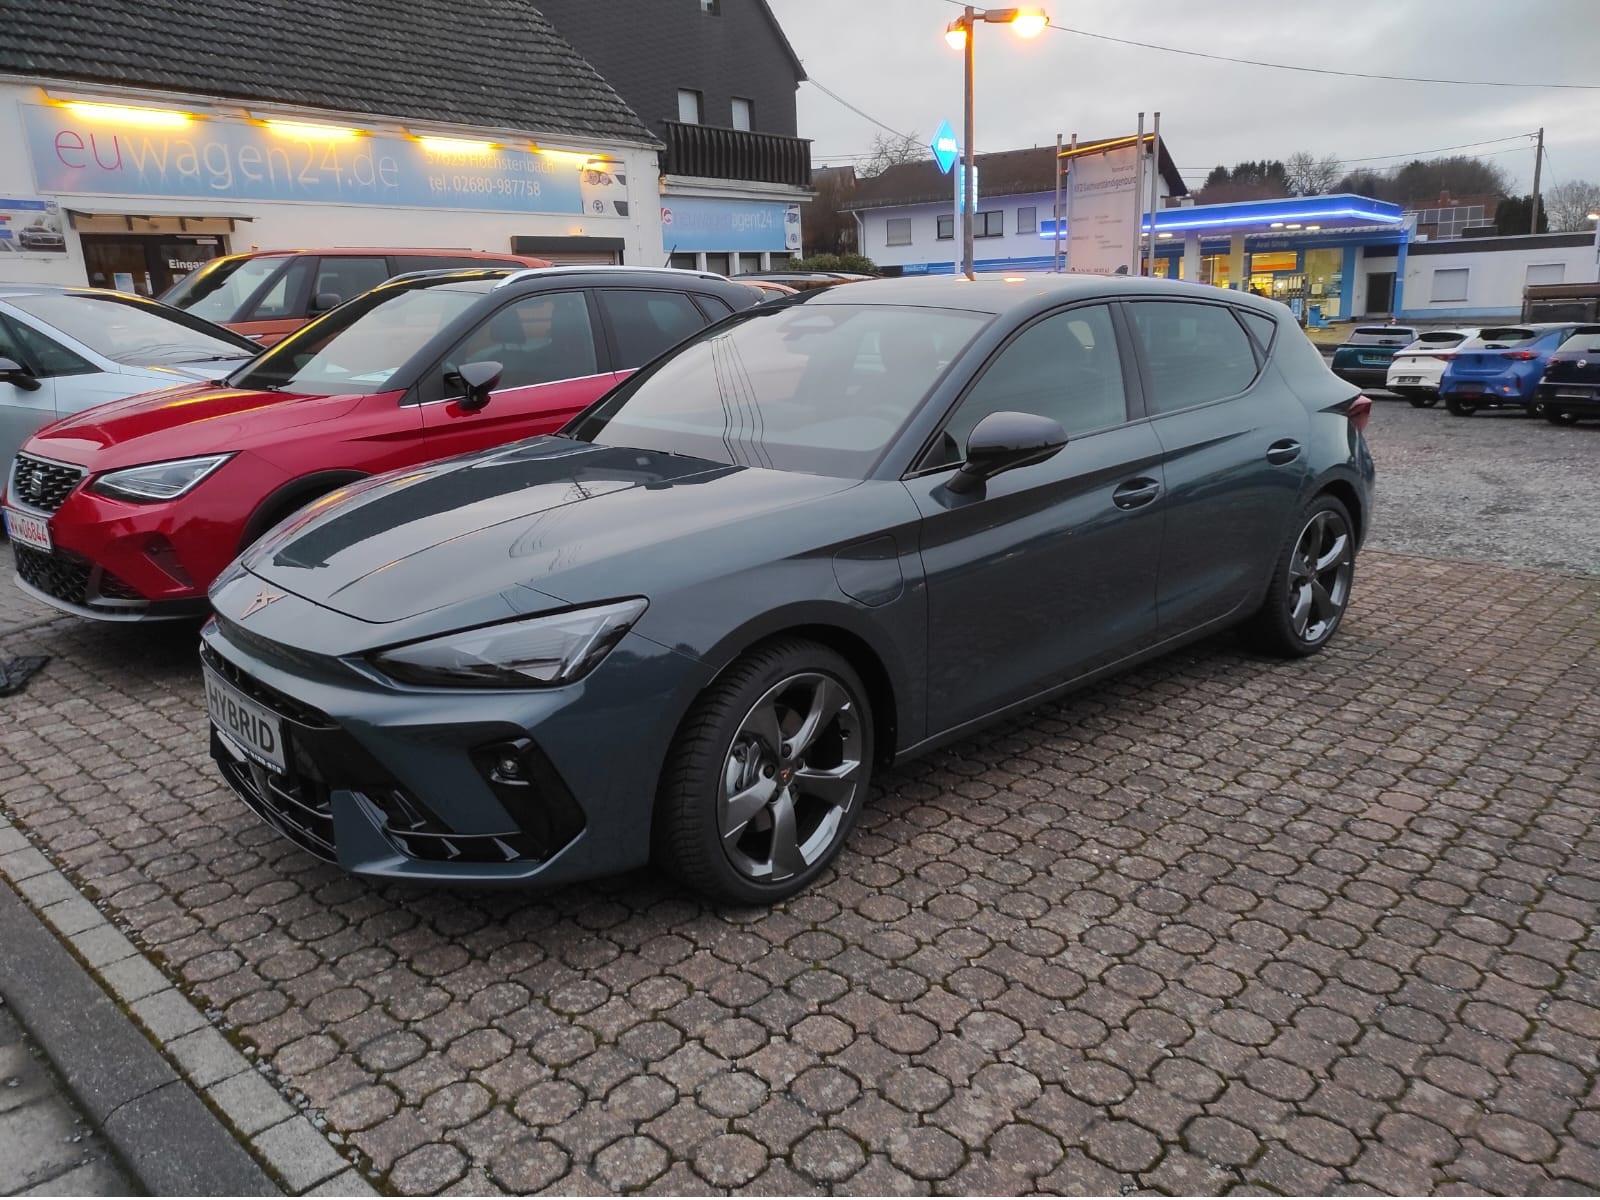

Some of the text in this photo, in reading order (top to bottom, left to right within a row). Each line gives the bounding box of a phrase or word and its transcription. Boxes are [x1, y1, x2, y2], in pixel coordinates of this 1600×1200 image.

[54, 129, 401, 190] euwagen24.de
[429, 174, 541, 197] tel. 02680-987758
[208, 680, 276, 754] HYBRID
